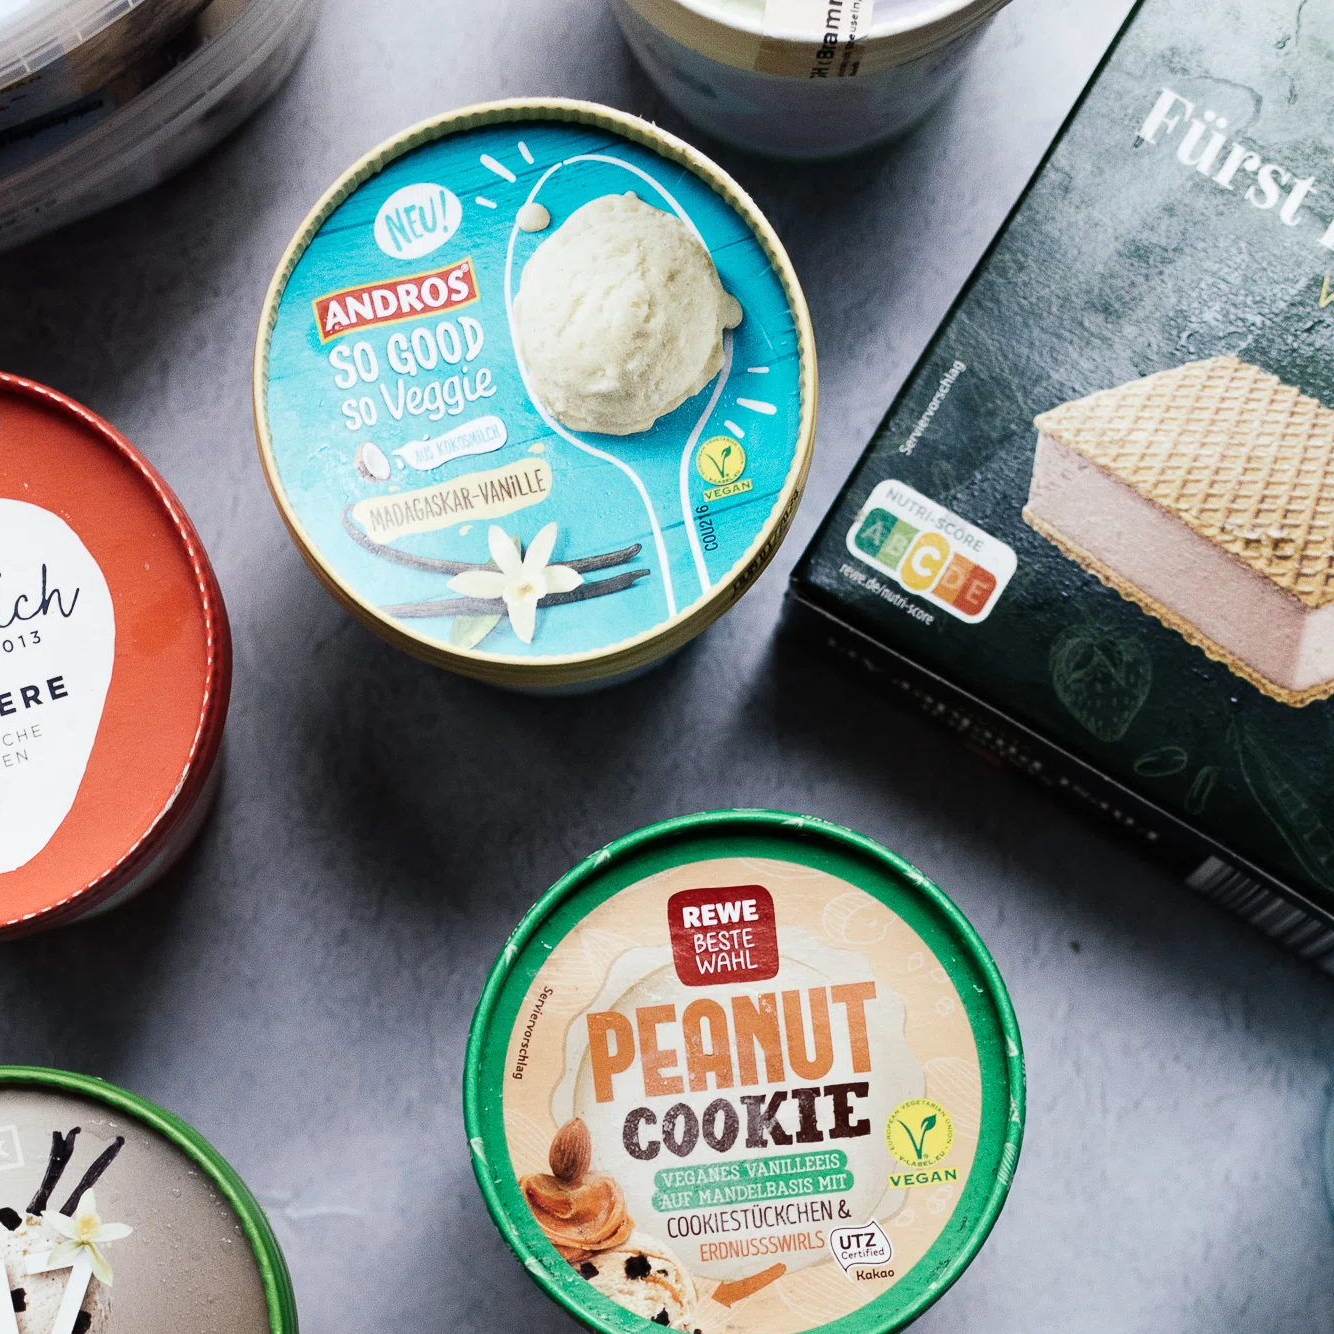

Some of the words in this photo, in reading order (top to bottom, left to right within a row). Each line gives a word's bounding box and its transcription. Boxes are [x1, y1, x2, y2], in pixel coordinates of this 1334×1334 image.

[1133, 86, 1323, 228] Fürst
[384, 189, 448, 252] NEU!
[324, 267, 471, 332] ANDROS
[387, 315, 484, 375] GOOD
[379, 364, 498, 420] Veggie
[898, 358, 968, 456] Serviervorschlag
[697, 503, 719, 553] COU216
[512, 985, 554, 1081] Serviervorschlag
[586, 981, 877, 1103] PEANUT
[622, 1082, 871, 1162] COOKIE
[662, 1162, 741, 1187] VEGANES
[747, 1153, 840, 1178] VANILLEEIS
[666, 1201, 834, 1239] COOKIESTÜCKCHEN
[839, 1232, 877, 1250] UTZ
[840, 1246, 886, 1260] Certified
[856, 1267, 896, 1282] Kakao
